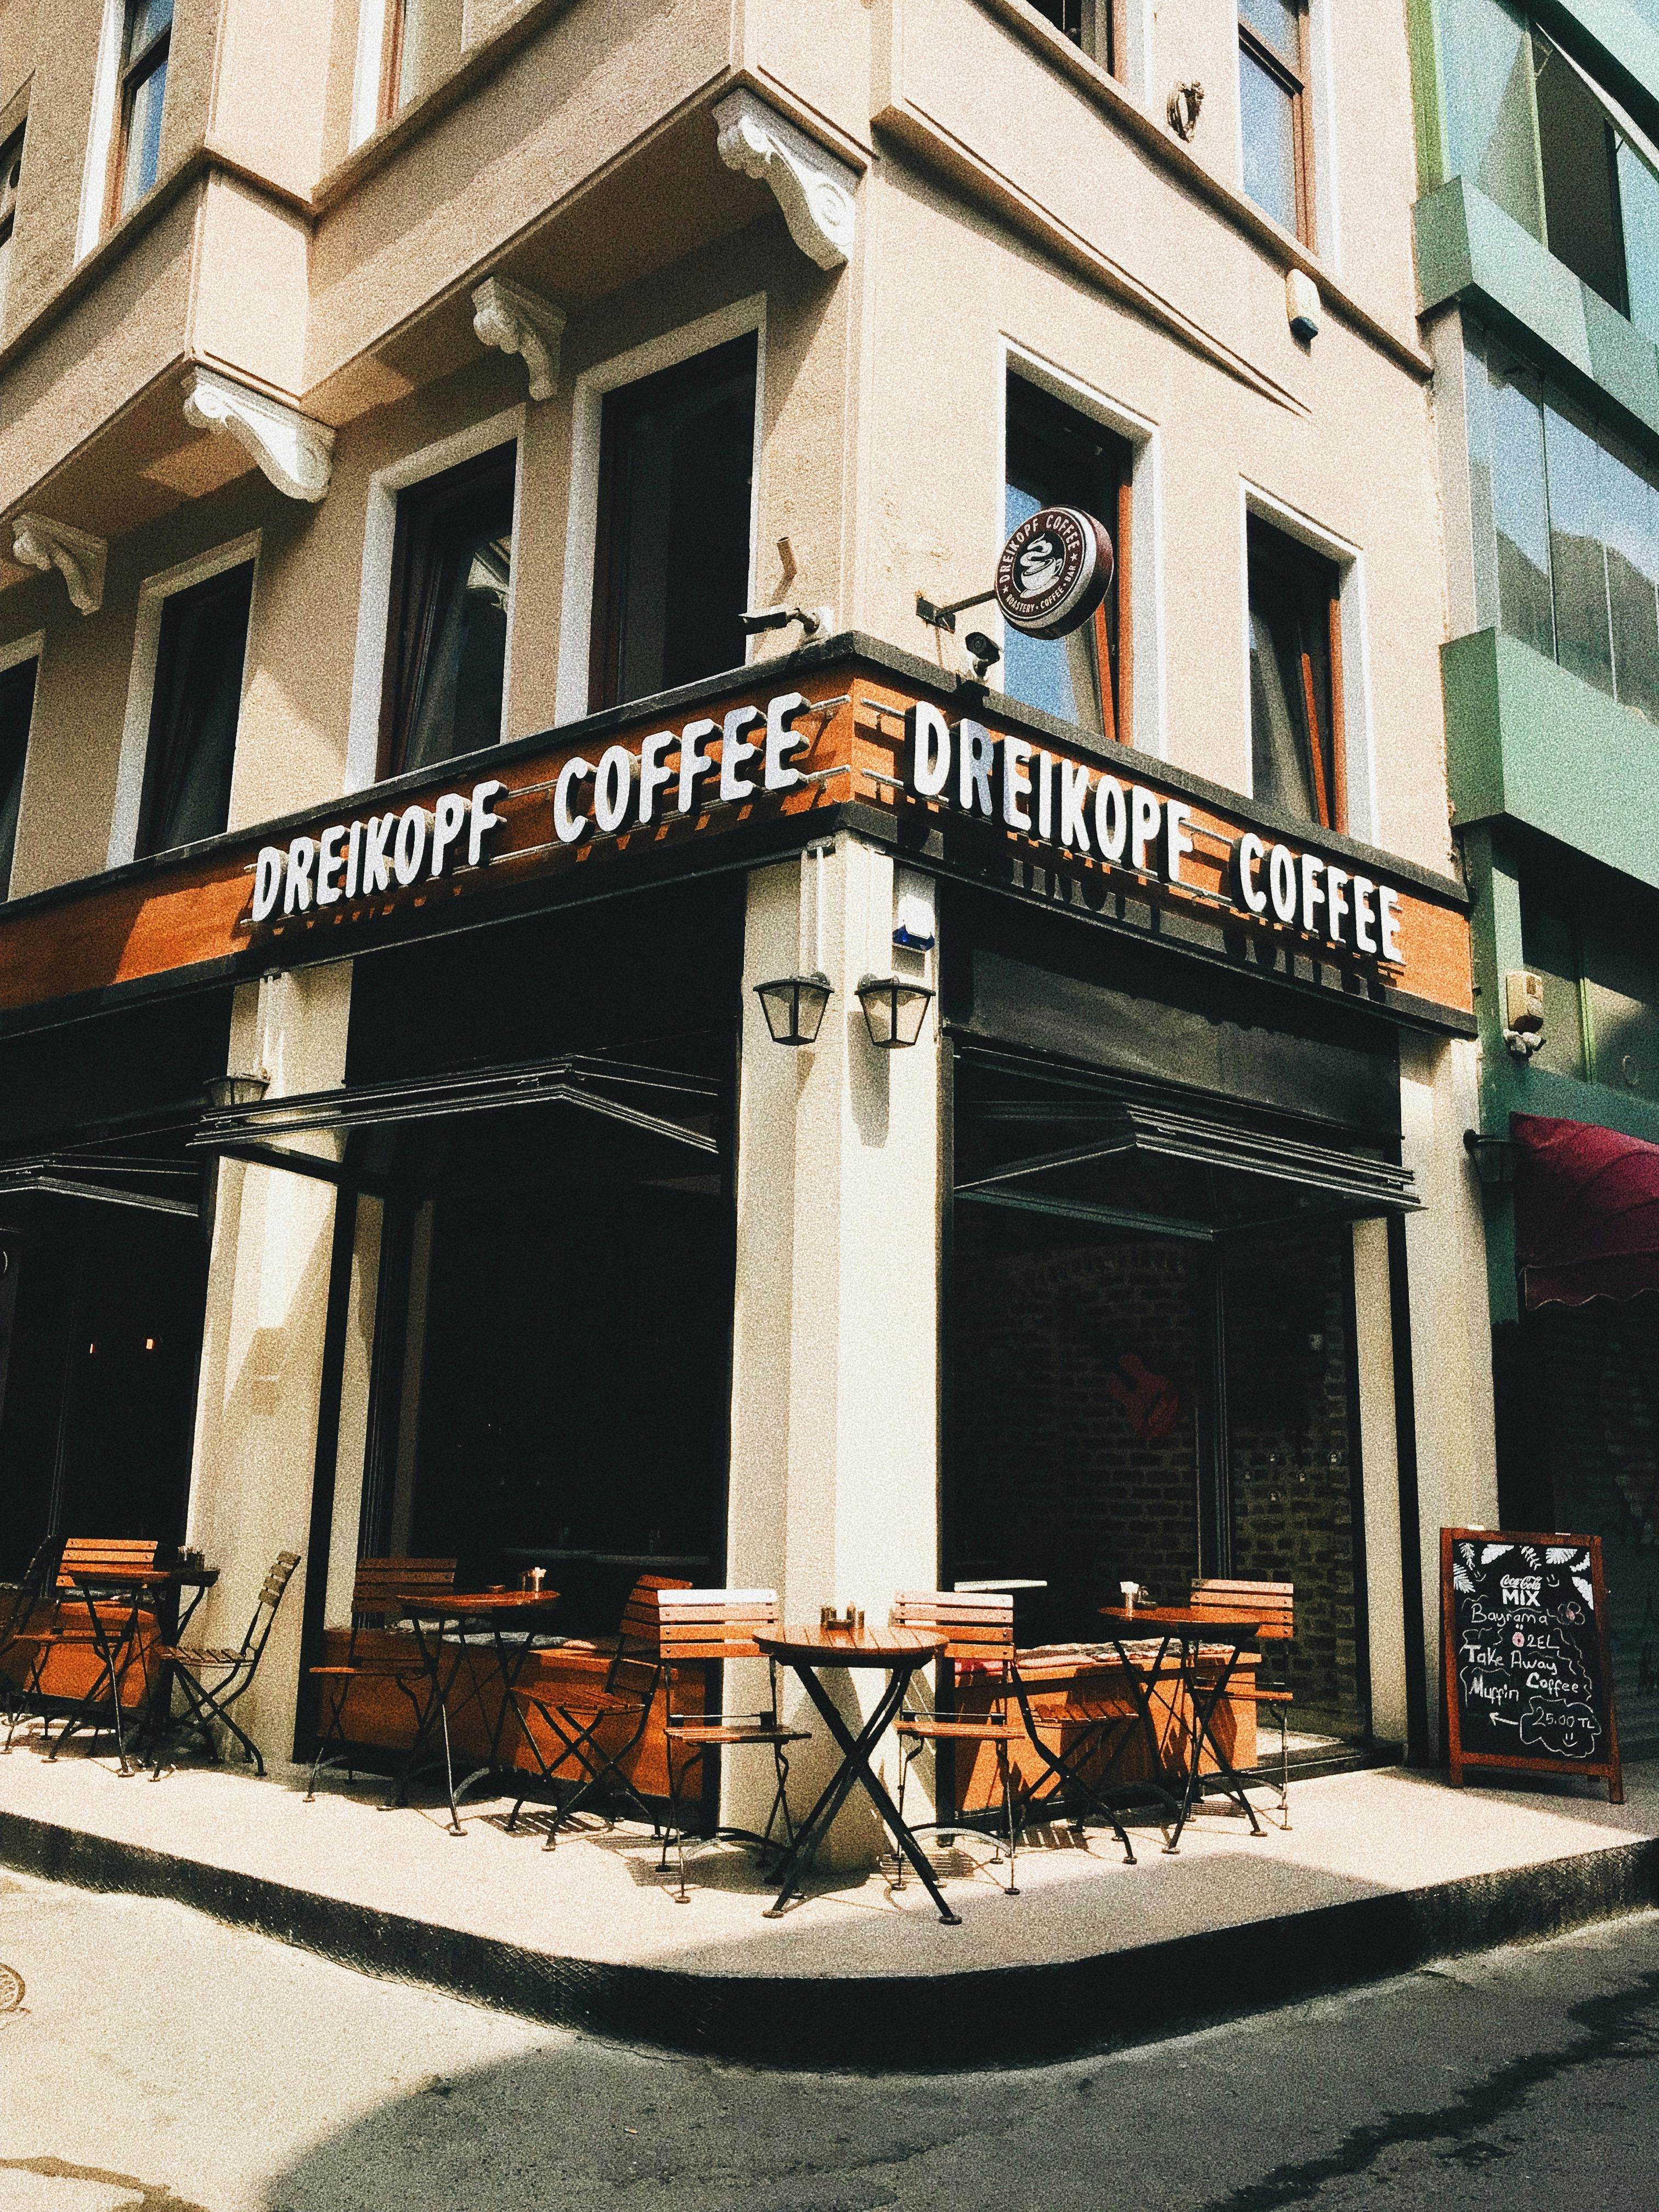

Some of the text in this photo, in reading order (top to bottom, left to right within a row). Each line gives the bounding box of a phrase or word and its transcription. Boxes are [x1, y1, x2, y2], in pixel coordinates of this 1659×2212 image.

[999, 514, 1080, 584] DREIKOPF COFFEE
[1005, 565, 1076, 613] ROASTERY COFFEE BAR
[251, 692, 810, 923] DREIKOPF COFFEE
[912, 700, 1403, 963] DREIKOPF COFFEE
[1500, 1574, 1543, 1590] Coca-Cola
[1502, 1589, 1541, 1607] MIX
[1471, 1604, 1549, 1628] Bayrama
[1464, 1644, 1558, 1675] Take Away
[1469, 1677, 1519, 1706] Muffin
[1526, 1672, 1579, 1697] Coffee
[1532, 1707, 1594, 1729] 25.00 TL
